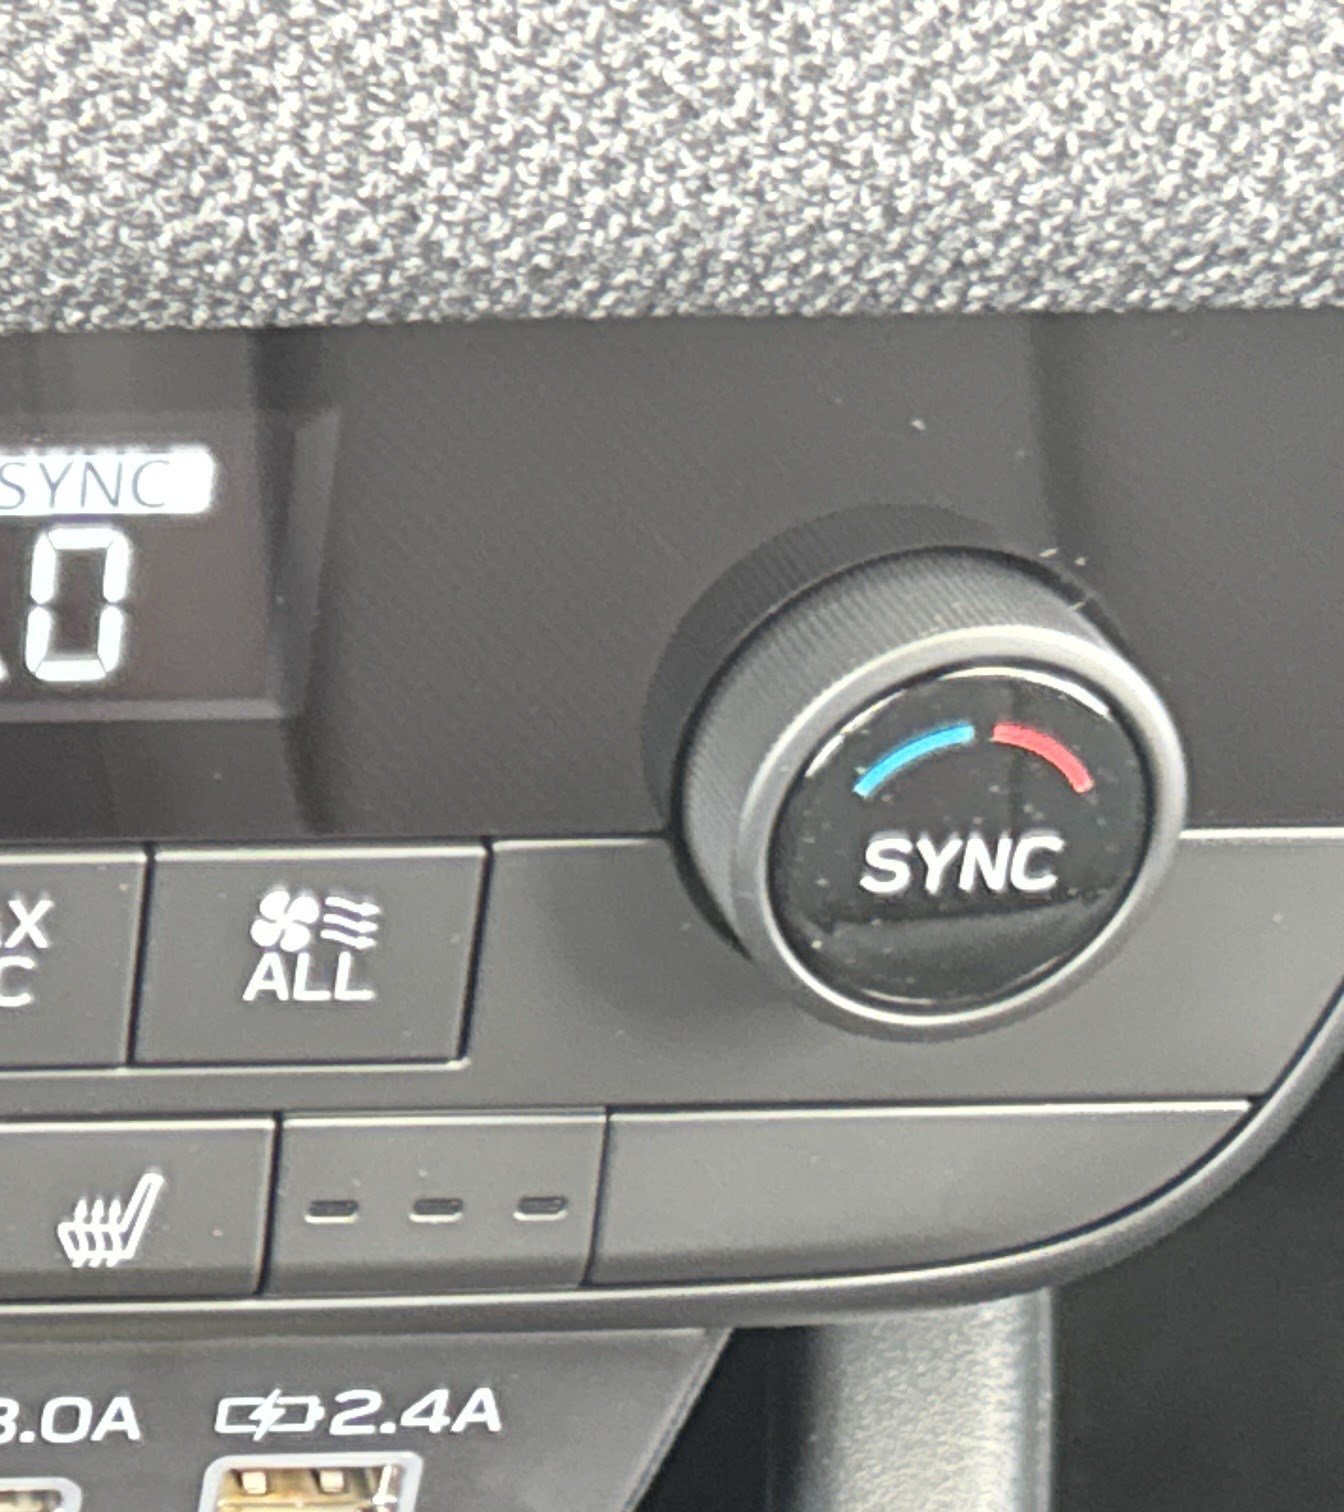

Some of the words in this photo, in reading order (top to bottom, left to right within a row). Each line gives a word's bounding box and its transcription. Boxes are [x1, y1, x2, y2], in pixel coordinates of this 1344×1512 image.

[858, 830, 1066, 896] SYNC
[242, 952, 376, 1003] ALL
[327, 1385, 503, 1437] 2.4A
